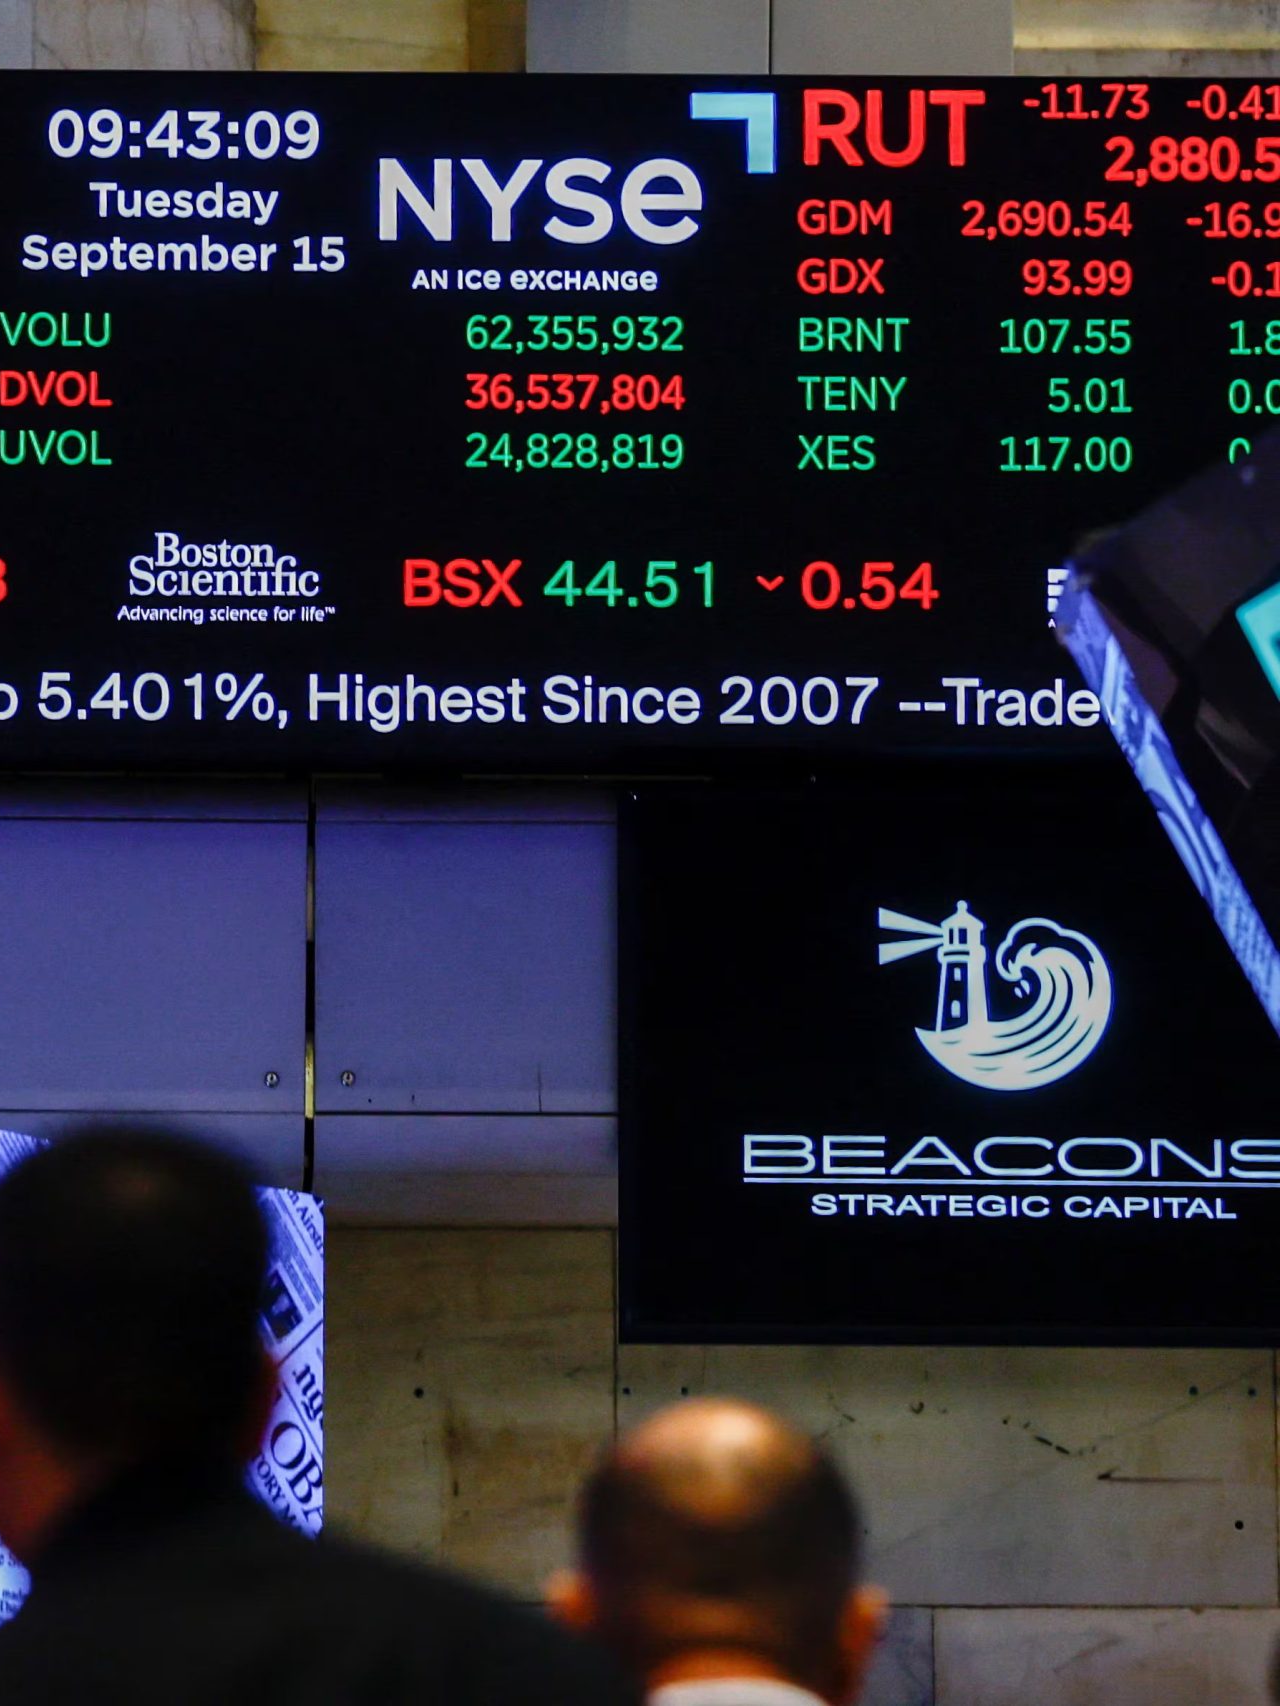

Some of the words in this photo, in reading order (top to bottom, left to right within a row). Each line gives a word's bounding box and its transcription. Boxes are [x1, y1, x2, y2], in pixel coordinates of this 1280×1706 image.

[1024, 83, 1149, 120] -11.73
[49, 109, 319, 160] 09:43:09
[803, 89, 986, 167] RUT
[89, 182, 279, 225] Tuesday
[797, 199, 892, 235] GDM
[961, 200, 1132, 240] 2,690.54
[22, 234, 277, 277] September
[293, 236, 345, 272] 15
[412, 269, 448, 289] AN
[797, 258, 884, 294] GDX
[1023, 259, 1132, 296] 93.99
[0, 312, 109, 347] VOLU
[467, 315, 683, 355] 62,355,932
[800, 317, 909, 352] BRNT
[1001, 319, 1130, 354] 107.55
[0, 370, 112, 407] DVOL
[465, 373, 685, 414] 36,537,804
[798, 376, 906, 410] TENY
[1049, 378, 1132, 413] 5.01
[0, 430, 112, 465] UVOL
[466, 433, 683, 472] 24,828,819
[798, 435, 875, 470] XES
[1001, 437, 1132, 472] 117.00
[154, 532, 275, 568] Boston
[129, 555, 320, 597] Scientific
[404, 558, 522, 607] BSX
[544, 561, 712, 607] 44.51
[801, 561, 939, 610] 0.54
[117, 605, 205, 625] Advancing
[209, 606, 268, 621] science
[273, 606, 296, 621] for
[38, 672, 290, 729] 5.401%,
[309, 674, 528, 732] Highest
[543, 675, 702, 724] Since
[720, 676, 879, 725] 2007
[899, 676, 1115, 727] --Trade
[811, 1194, 1050, 1217] STRATEGIC
[1064, 1196, 1237, 1219] CAPITAL
